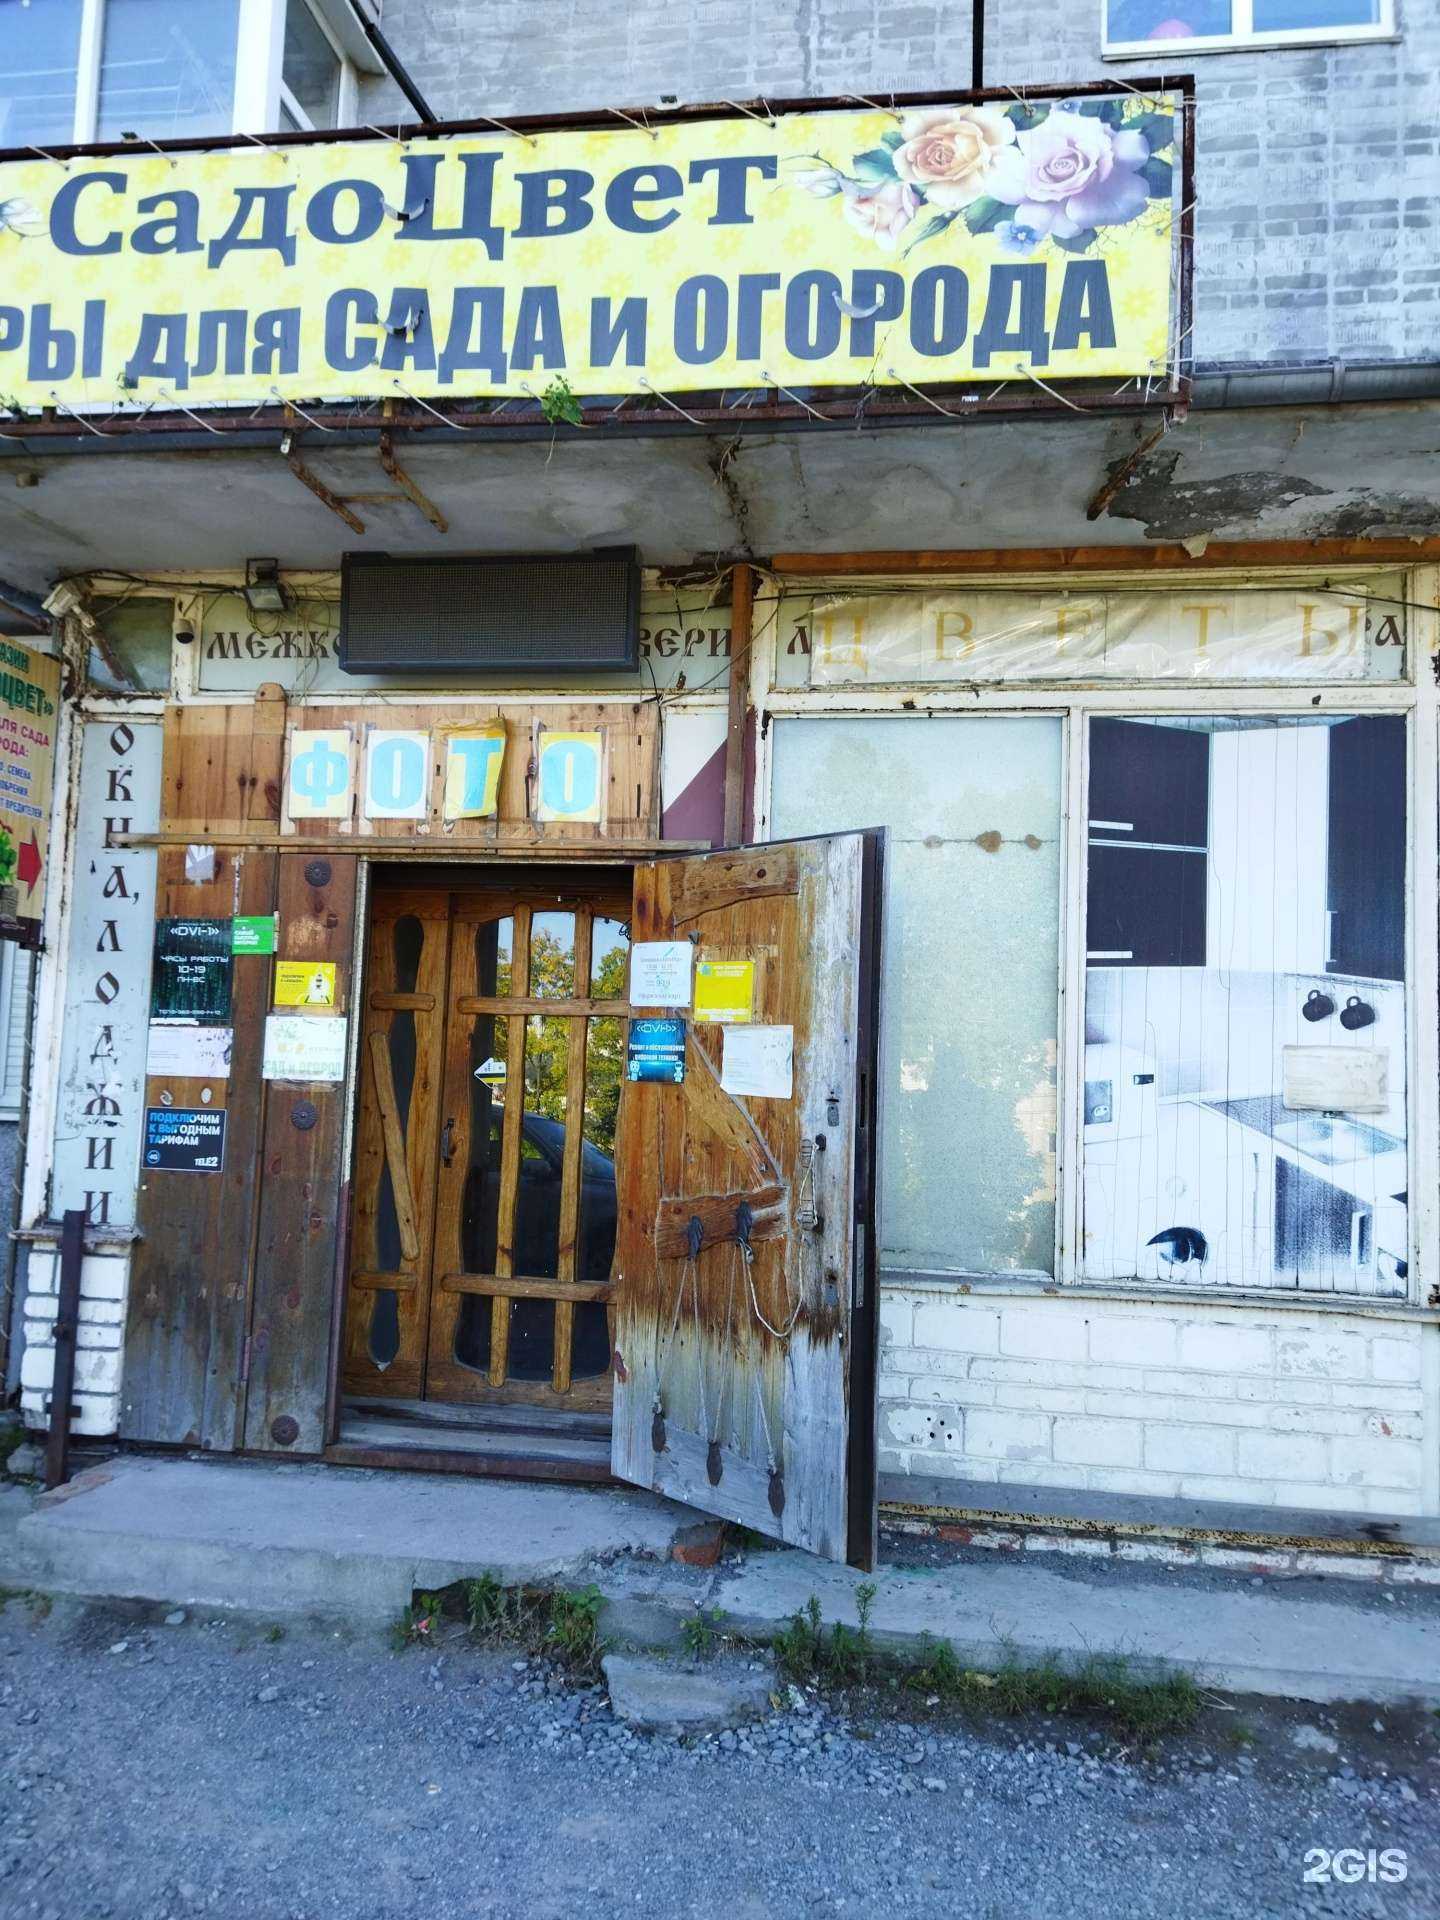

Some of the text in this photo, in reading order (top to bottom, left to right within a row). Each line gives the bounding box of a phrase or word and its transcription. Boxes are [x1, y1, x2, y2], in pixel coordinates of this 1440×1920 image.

[49, 151, 777, 268] СадоЦвет
[325, 285, 566, 384] САДА
[673, 259, 1117, 367] ОГОРОДА
[823, 604, 1362, 677] ЦВЕТЫ
[0, 671, 54, 717] ЦВЕТ»
[0, 736, 29, 757] ОДА:
[20, 725, 49, 747] САДА
[290, 738, 598, 814] ФОТО
[161, 955, 229, 963] ЧАСЫ РАБОТЫ
[178, 965, 206, 974] 10-19
[149, 1112, 220, 1124] ПОДКЛЮЧИМ
[148, 1134, 199, 1146] ТАРИФАМ
[158, 1124, 221, 1136] ВЫГОДНЫМ
